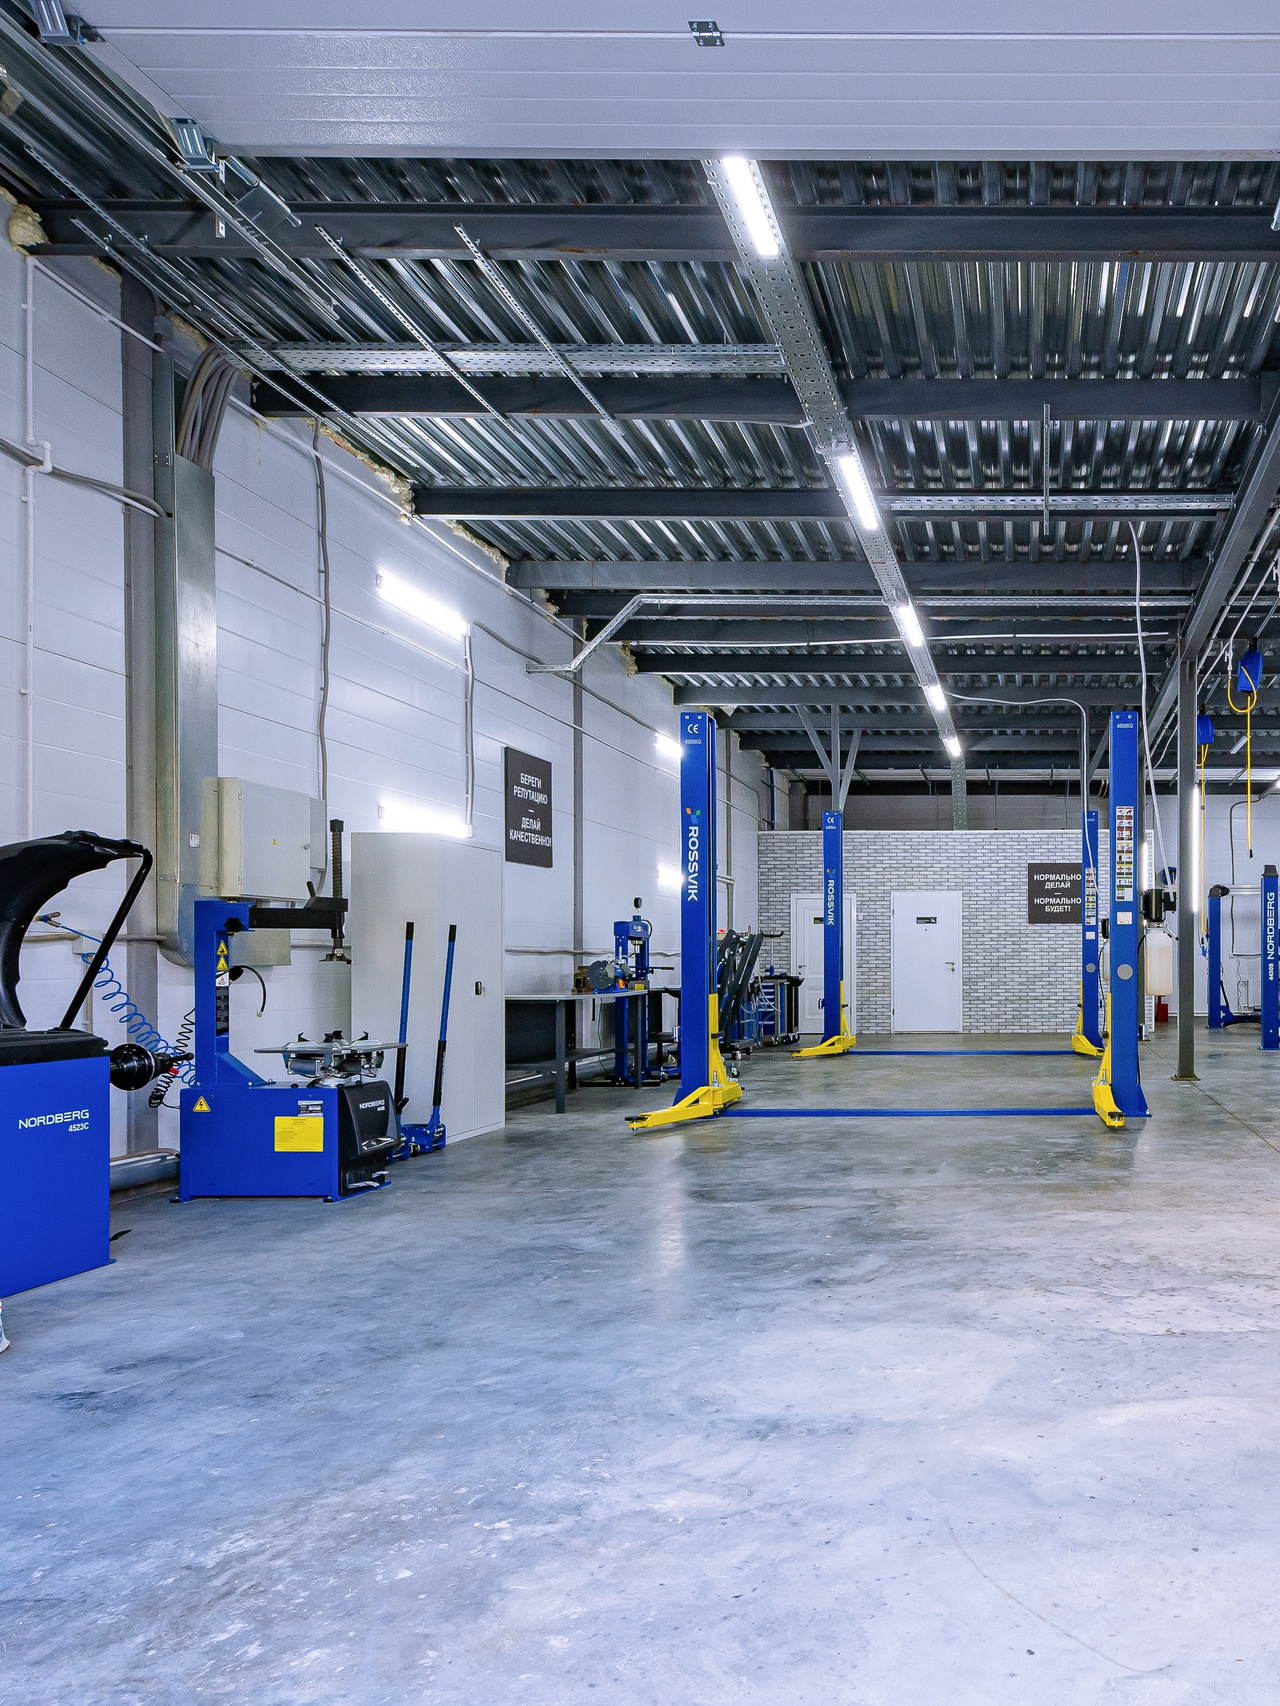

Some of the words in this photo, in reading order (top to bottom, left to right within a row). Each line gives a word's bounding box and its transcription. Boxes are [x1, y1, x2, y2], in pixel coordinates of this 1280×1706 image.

[520, 772, 542, 790] БЕРЕГИ
[513, 785, 548, 805] РЕПУТАЦИЮ
[521, 816, 541, 831] ДЕЛАЙ
[509, 828, 552, 847] КАЧЕСТВЕННО!
[687, 826, 699, 902] ROSSVIK
[1033, 873, 1082, 881] НОРМАЛЬНО
[1044, 881, 1071, 890] ДЕЛАЙ
[827, 879, 835, 926] ROSSVIK
[1034, 897, 1082, 905] НОРМАЛЬНО
[1044, 905, 1071, 913] БУДЕТ!
[1266, 892, 1275, 960] NORDBERG
[18, 1109, 90, 1130] NORDBERG
[67, 1122, 90, 1133] 4523C
